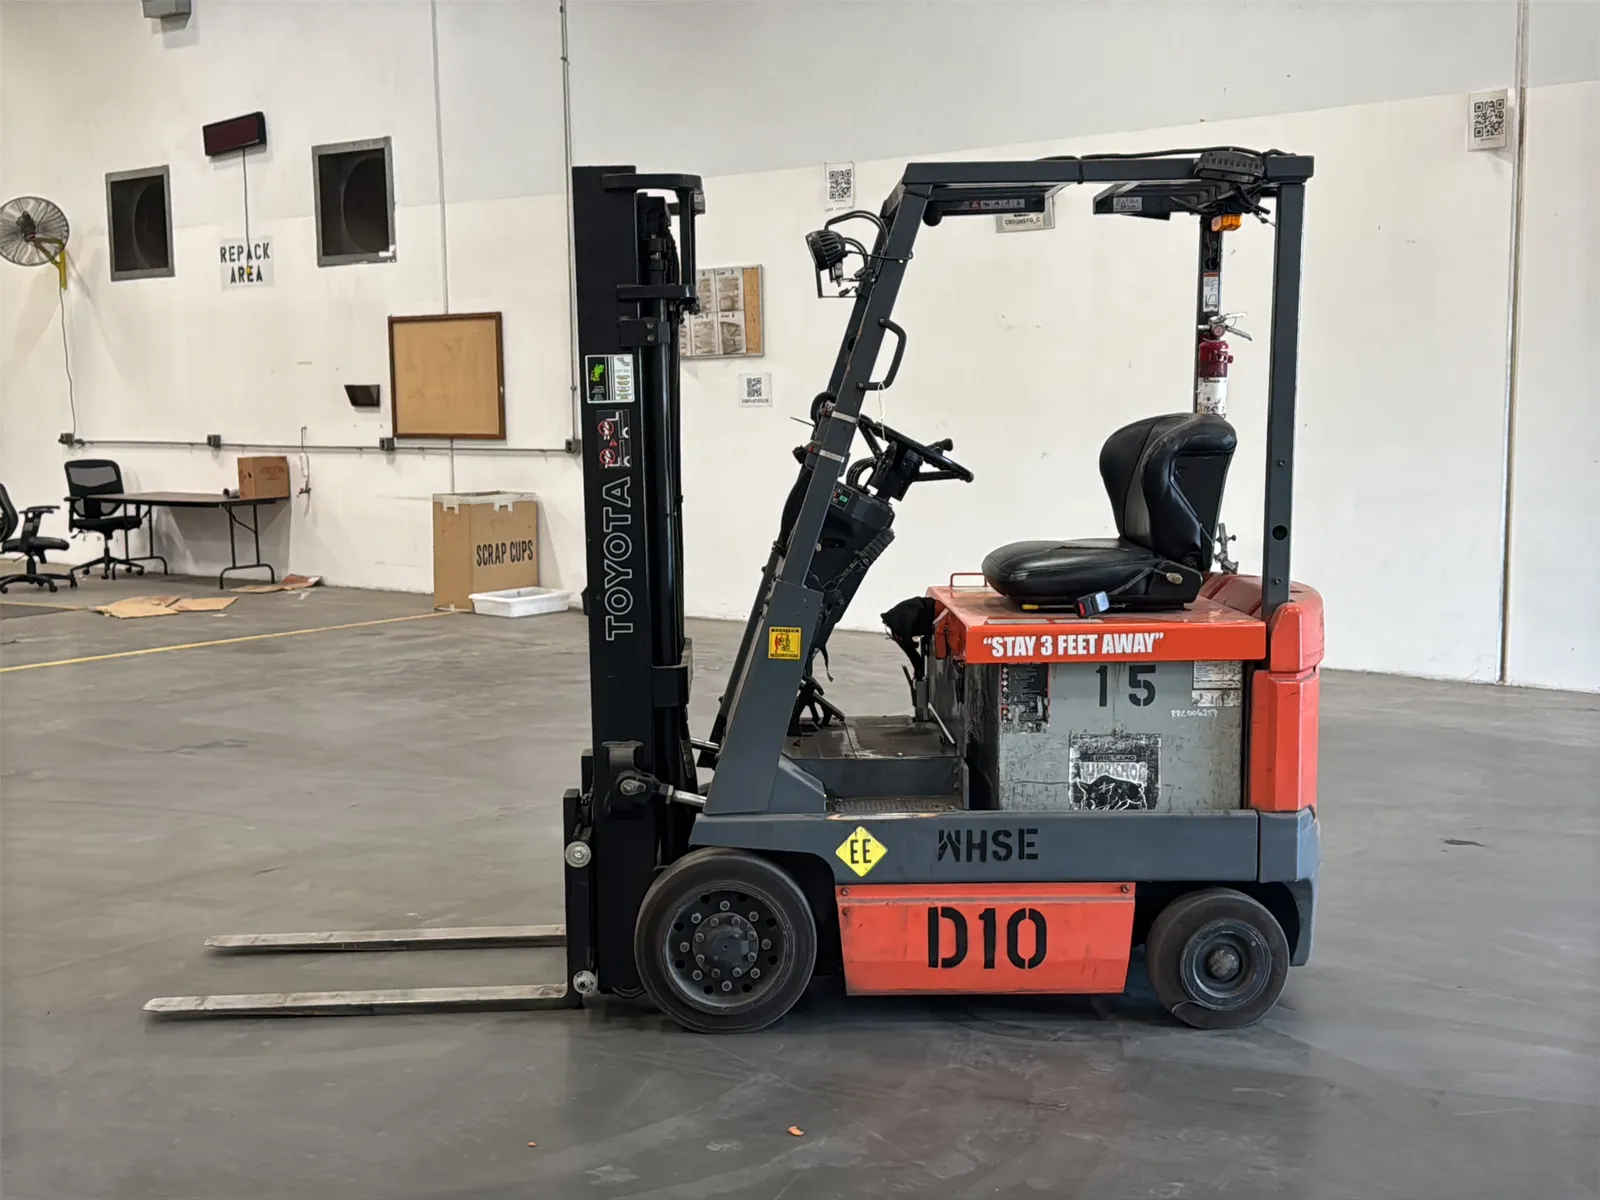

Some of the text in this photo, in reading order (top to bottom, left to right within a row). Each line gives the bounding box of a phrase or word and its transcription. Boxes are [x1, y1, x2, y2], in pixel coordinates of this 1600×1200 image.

[219, 241, 270, 264] REPACK
[230, 264, 263, 285] AREA
[476, 539, 534, 567] SCRAP CUPS
[602, 475, 634, 642] TOYOTA
[1040, 635, 1053, 656] 3
[1057, 633, 1099, 656] FEET
[849, 838, 872, 865] EE
[937, 828, 1039, 862] WHSE
[927, 906, 1048, 970] D10
